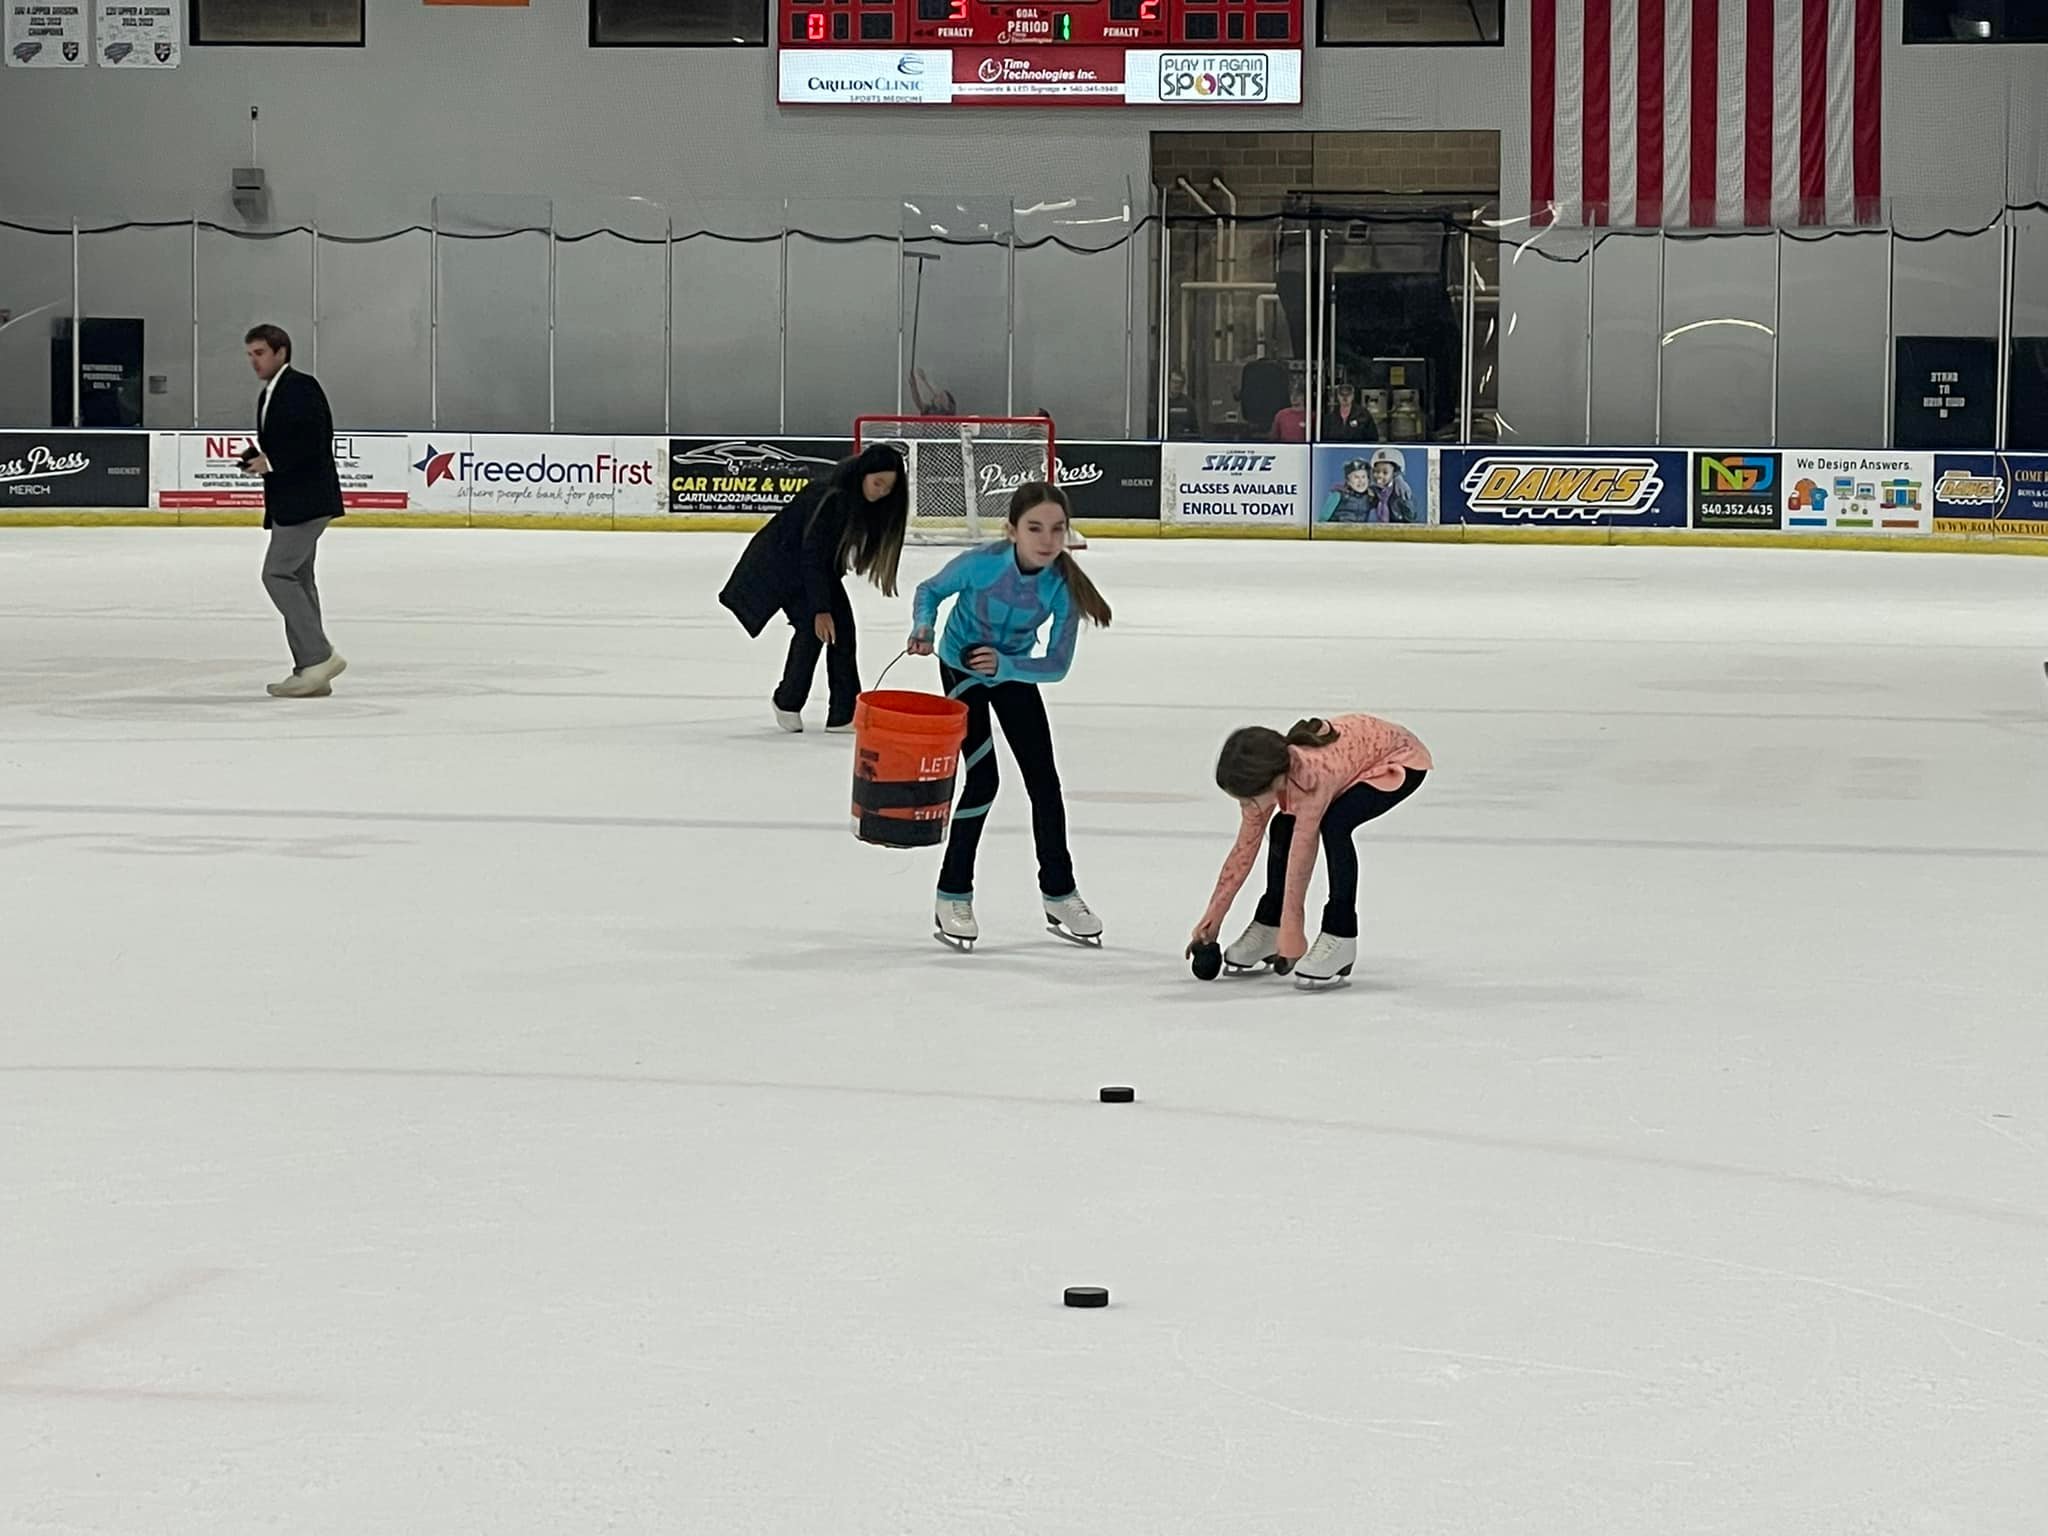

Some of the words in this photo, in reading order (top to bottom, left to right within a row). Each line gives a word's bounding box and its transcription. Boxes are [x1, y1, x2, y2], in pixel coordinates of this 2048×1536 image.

[1016, 8, 1038, 18] GOAL
[808, 14, 824, 40] 0
[938, 27, 974, 38] PENALTY
[1007, 20, 1049, 33] PERIOD
[1103, 27, 1139, 38] PENALTY
[1003, 58, 1030, 70] Time
[1164, 58, 1198, 71] PLAY
[1203, 58, 1215, 71] IT
[1219, 58, 1263, 71] AGAIN
[1003, 69, 1075, 82] Technologies
[1077, 68, 1097, 80] Inc.
[808, 77, 872, 92] CARILION
[875, 77, 923, 91] CLINIC
[1163, 72, 1264, 96] SPORTS
[28, 446, 89, 475] Press
[1201, 455, 1276, 471] SKATE
[1796, 457, 1814, 470] We
[1818, 458, 1857, 472] Design
[1859, 459, 1912, 471] Answers.
[2015, 470, 2042, 483] COME
[9, 484, 51, 495] MERCH
[672, 477, 707, 491] CAR
[712, 477, 757, 492] TUNZ
[761, 477, 774, 492] &
[1179, 483, 1230, 494] CLASSES
[1233, 483, 1298, 495] AVAILABLE
[1475, 467, 1649, 503] DAWGS
[497, 486, 532, 503] people
[535, 486, 563, 500] bank
[1183, 502, 1238, 515] ENROLL
[1240, 503, 1294, 516] TODAY!
[1701, 503, 1773, 516] 540.352.4435
[1936, 520, 2048, 535] WWW.ROANOKEYOU
